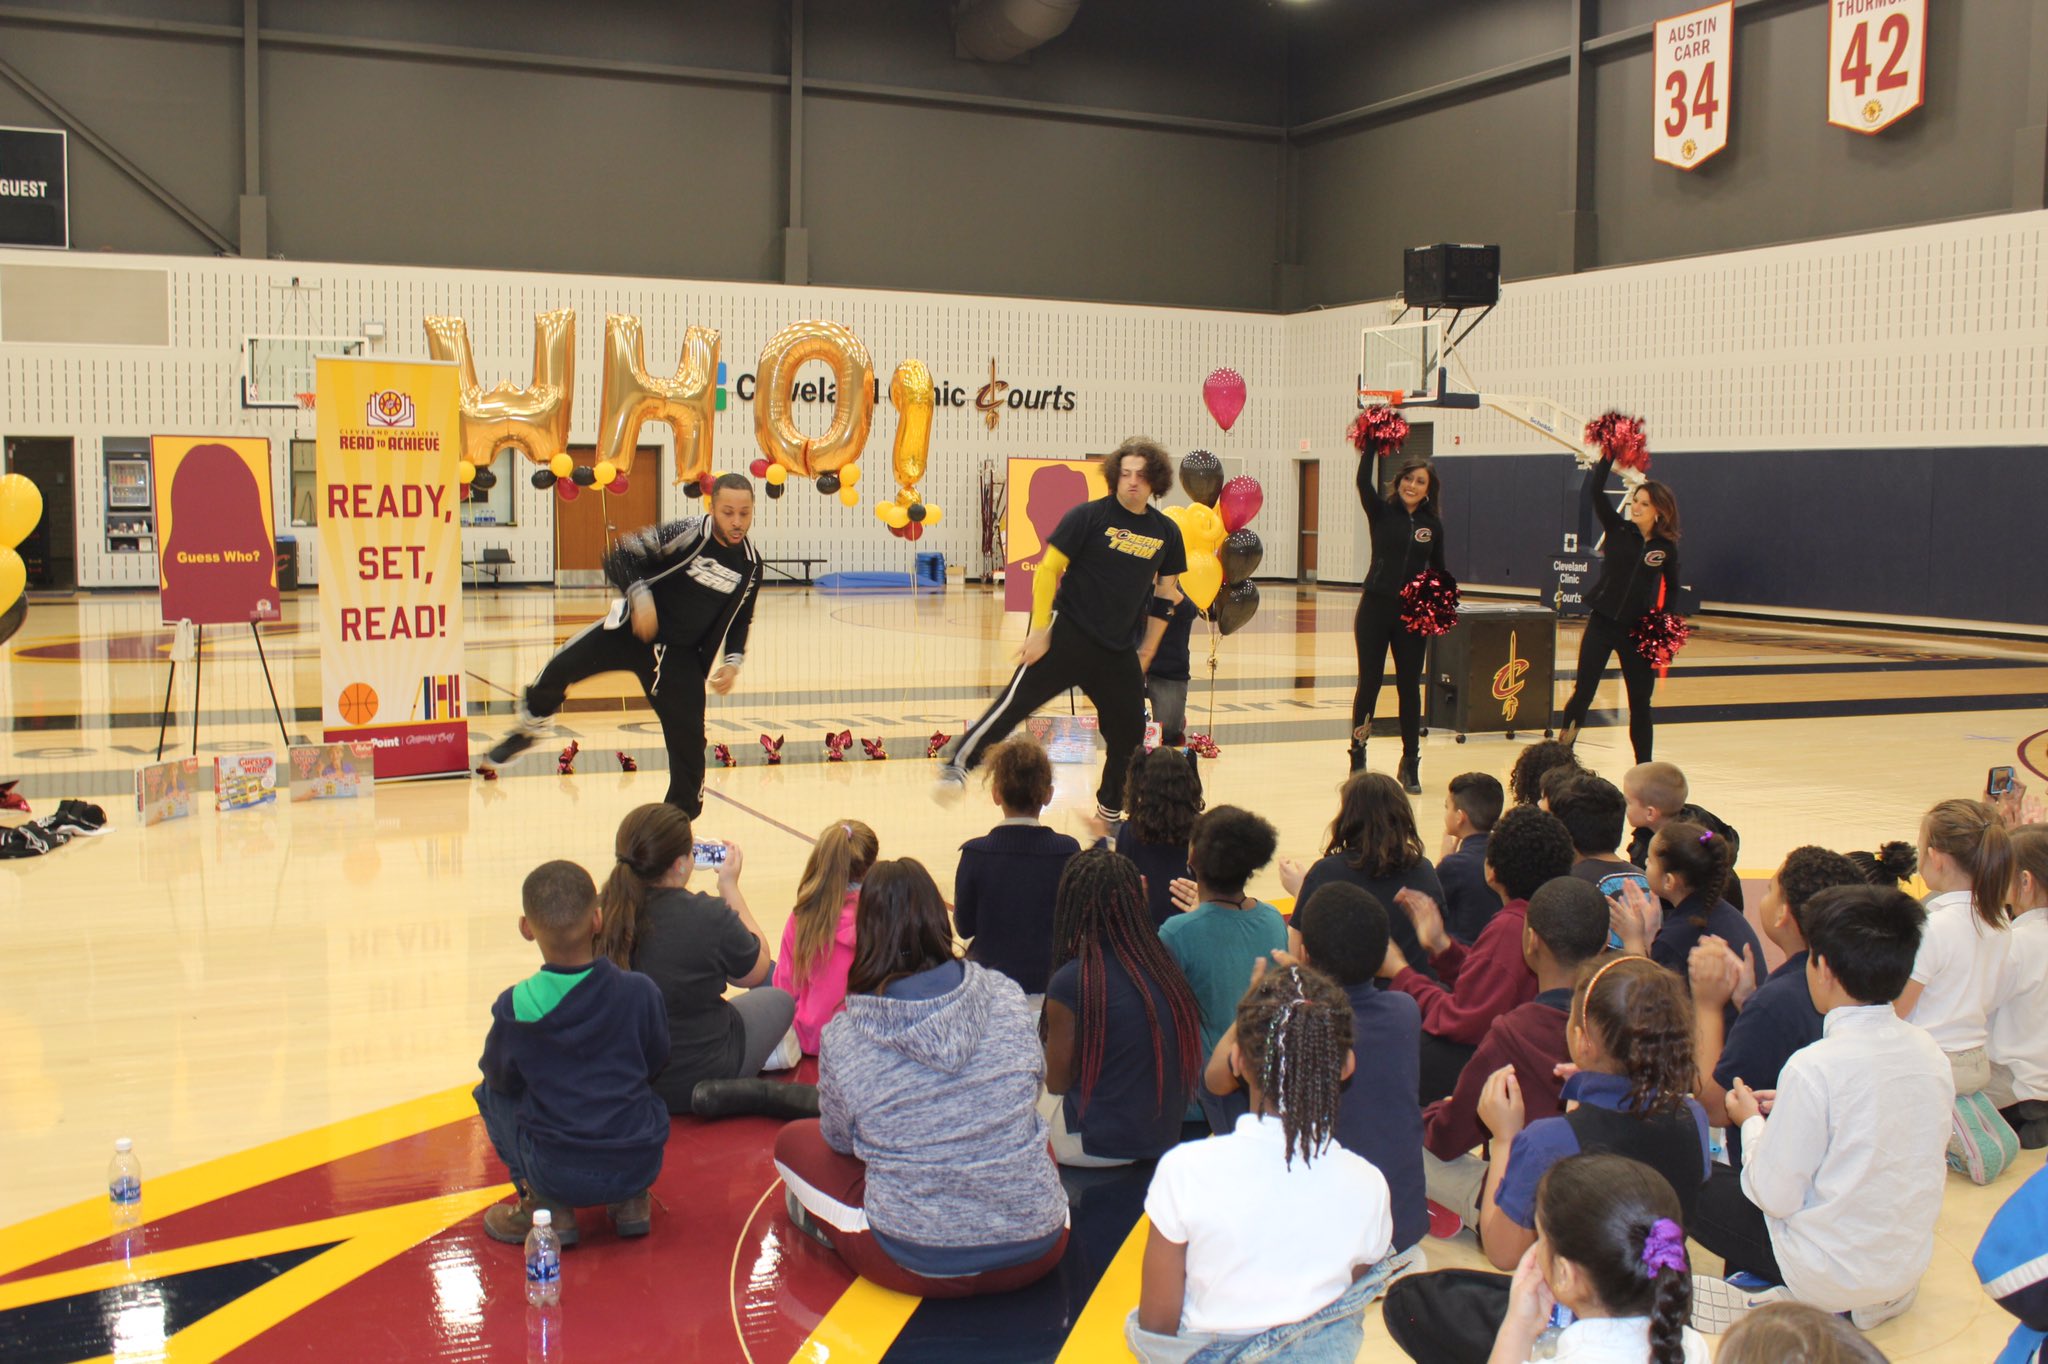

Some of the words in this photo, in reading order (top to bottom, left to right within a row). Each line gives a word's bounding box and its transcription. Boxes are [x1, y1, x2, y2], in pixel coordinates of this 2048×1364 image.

[1668, 17, 1717, 44] AUSTIN
[1674, 39, 1711, 62] CARR
[1840, 13, 1910, 97] 42
[1664, 61, 1719, 138] 34
[0, 178, 47, 198] GUEST
[339, 435, 375, 450] READ
[388, 437, 440, 452] ACHIEVE
[328, 484, 452, 524] READY,
[176, 551, 220, 563] Guess
[223, 550, 260, 563] Who?
[1109, 537, 1158, 560] TEAM
[358, 545, 433, 585] SET,
[1553, 560, 1588, 573] Cleveland
[1560, 573, 1580, 584] Clinic
[341, 604, 446, 642] READ!
